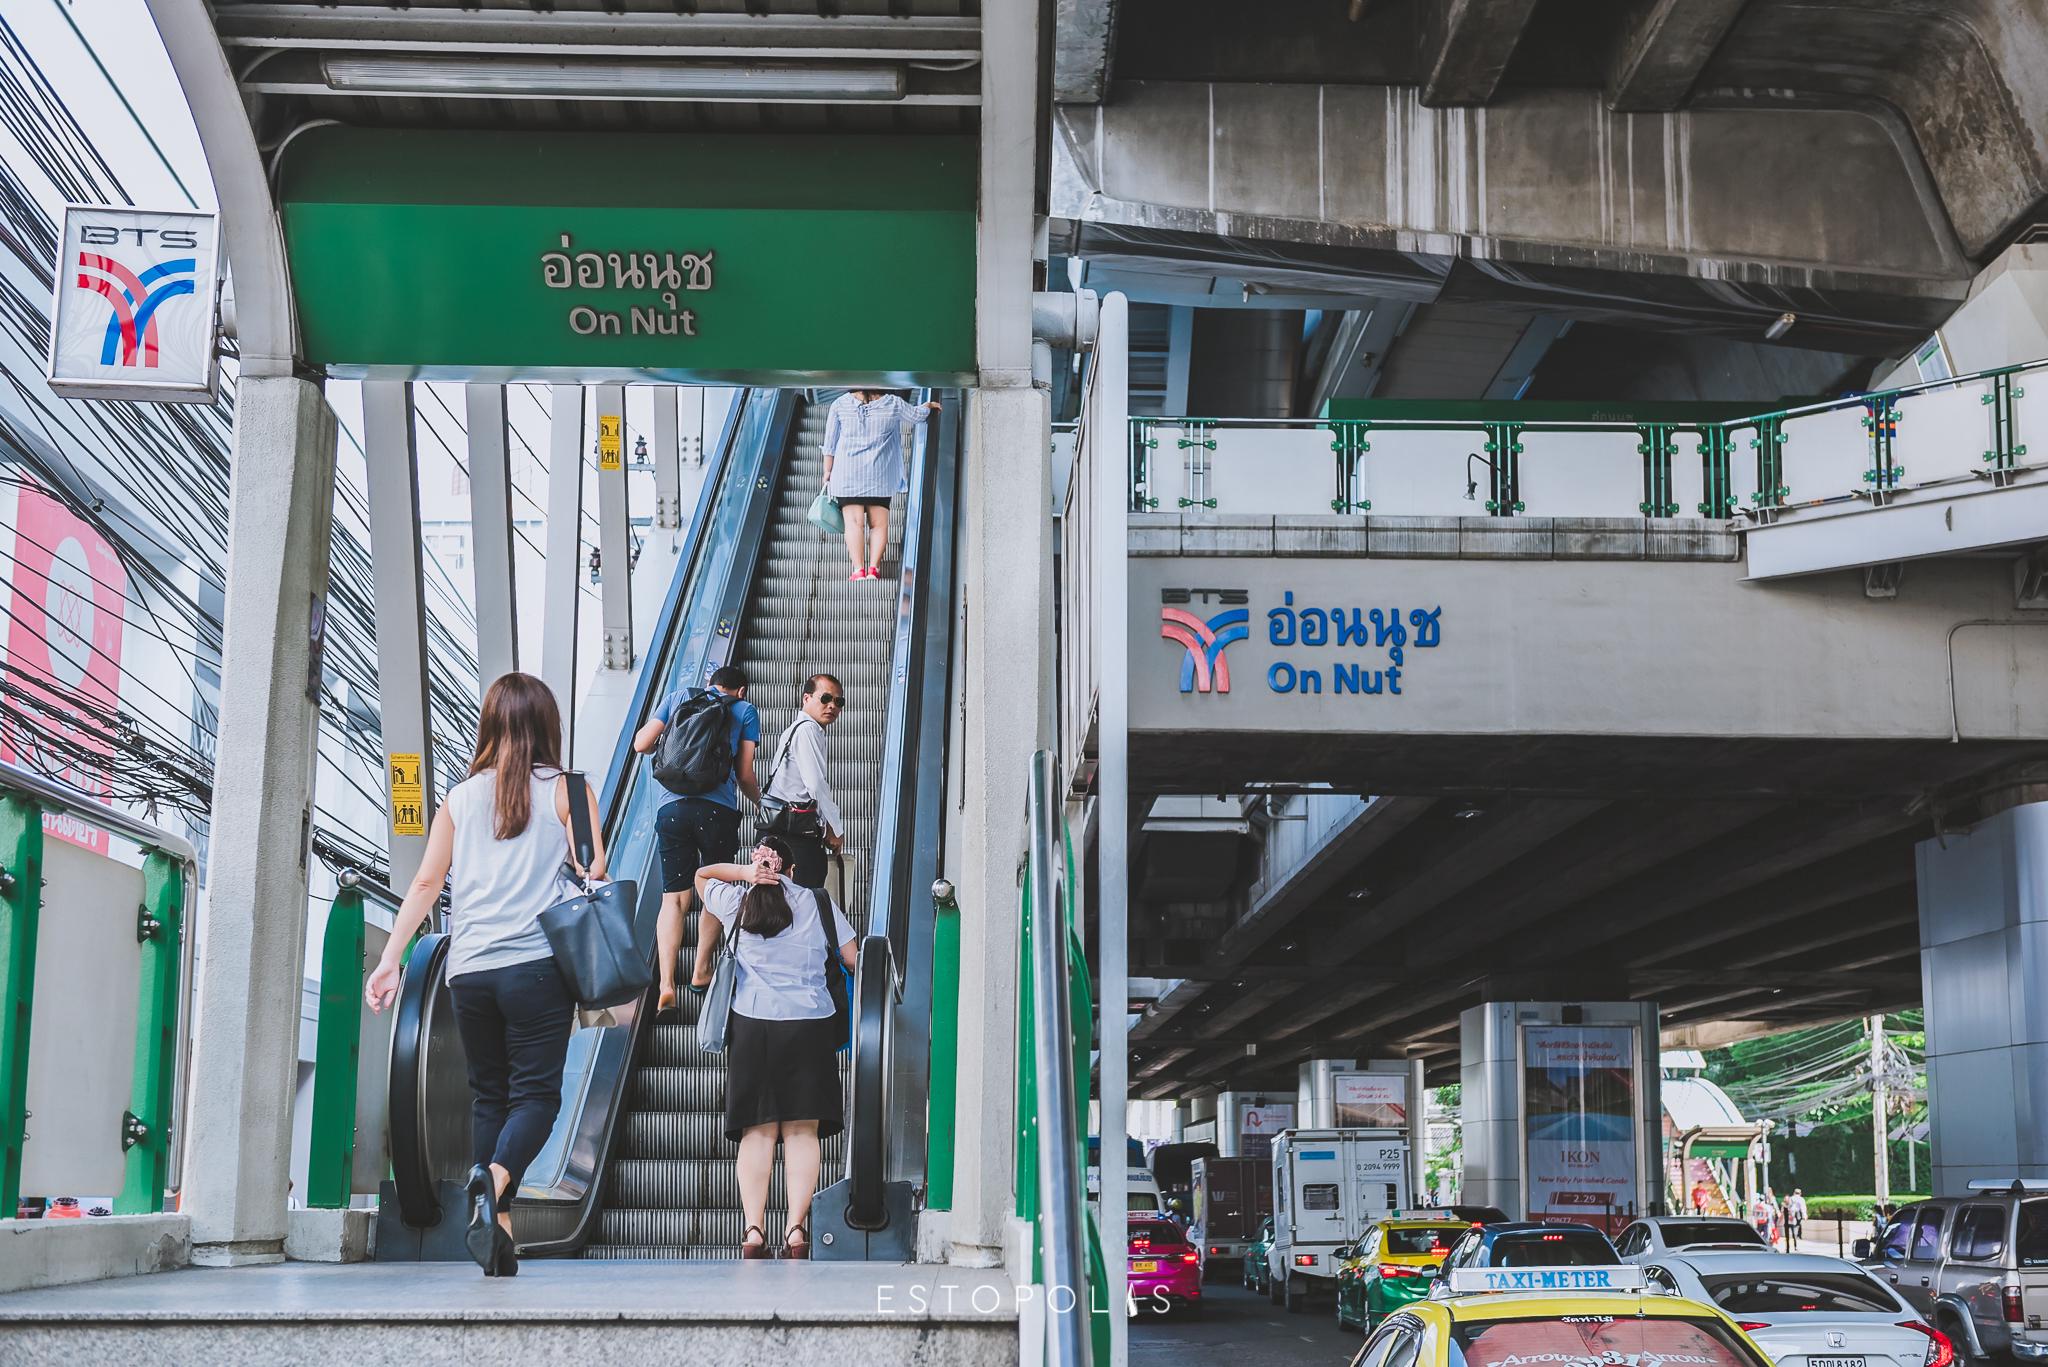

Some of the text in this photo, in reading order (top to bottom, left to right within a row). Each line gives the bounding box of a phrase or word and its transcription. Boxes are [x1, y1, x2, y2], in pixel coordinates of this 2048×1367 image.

[80, 225, 197, 249] BTS
[540, 234, 711, 310] อ่อนนุช
[569, 306, 696, 336] On Nut
[1161, 588, 1248, 604] BTS
[1267, 590, 1442, 666] อ่อนนุช
[1267, 662, 1402, 694] On Nut
[1379, 1148, 1400, 1159] P25
[1560, 1150, 1601, 1163] IKON
[1363, 1163, 1381, 1171] 2094
[1382, 1162, 1401, 1170] 9999
[1573, 1194, 1596, 1204] 2.29
[1485, 1270, 1612, 1289] TAXI-METER
